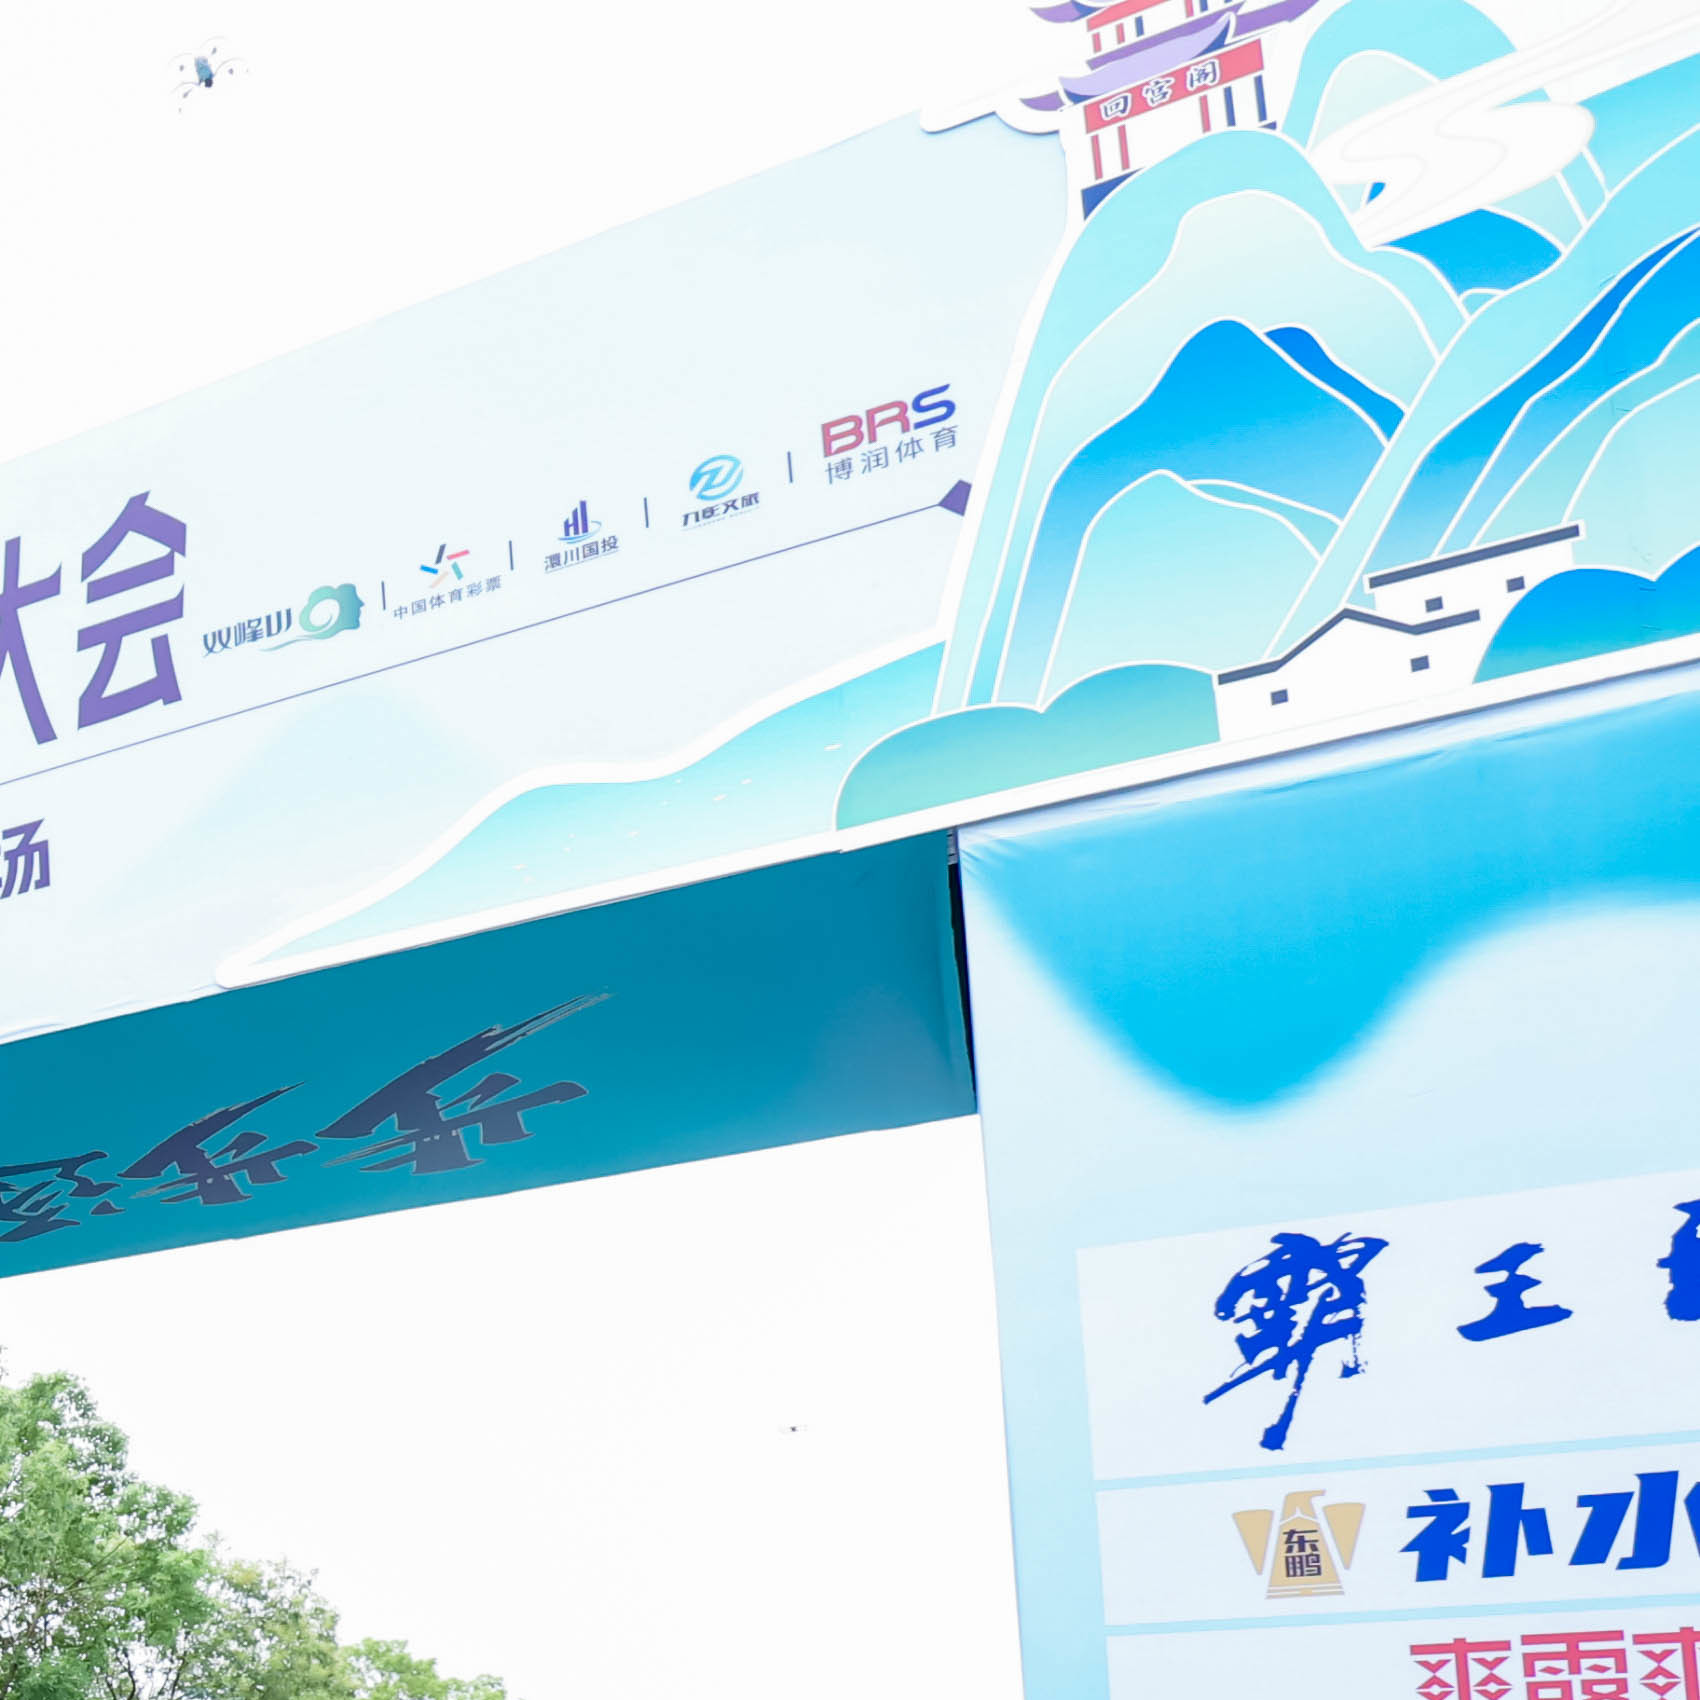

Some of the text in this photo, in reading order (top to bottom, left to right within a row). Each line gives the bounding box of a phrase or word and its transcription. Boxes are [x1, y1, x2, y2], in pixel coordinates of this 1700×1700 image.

[820, 383, 958, 459] BRS
[824, 424, 959, 486] 博润体育
[392, 574, 503, 622] 中国体育彩票
